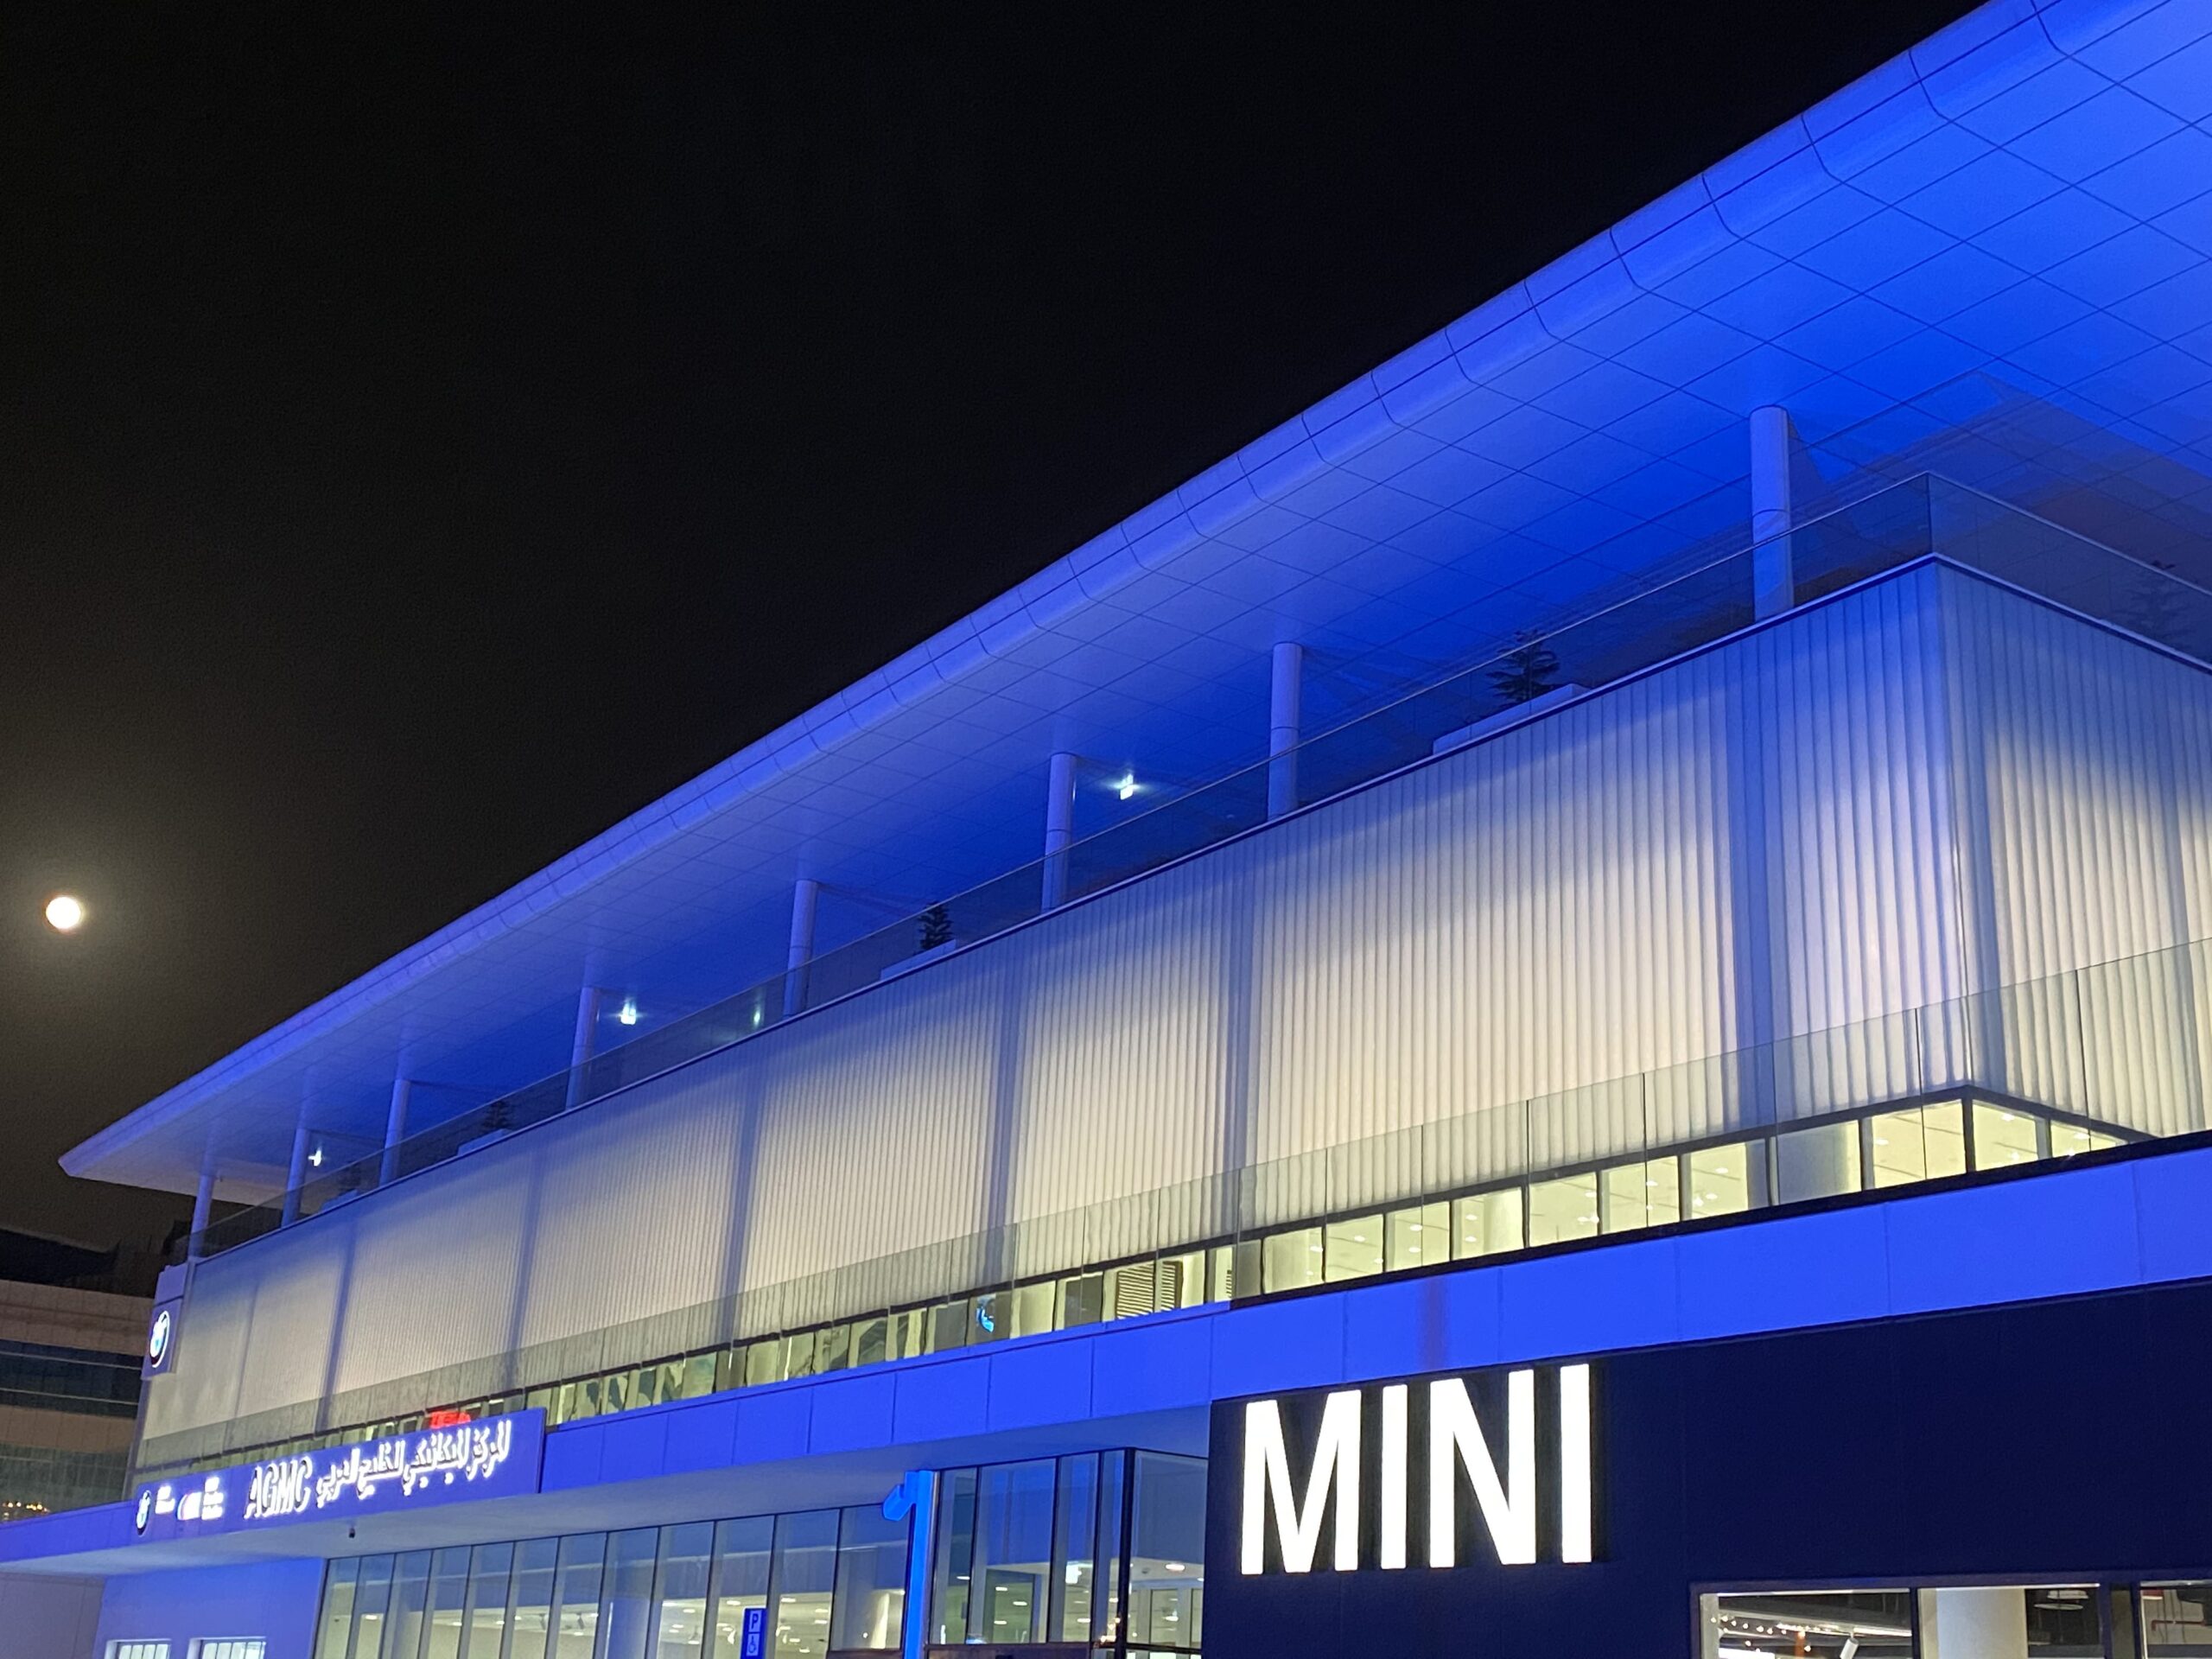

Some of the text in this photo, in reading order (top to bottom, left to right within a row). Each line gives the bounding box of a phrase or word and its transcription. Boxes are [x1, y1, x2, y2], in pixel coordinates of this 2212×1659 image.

[244, 1456, 312, 1518] AGMC
[1242, 1363, 1592, 1574] MINI
[752, 1612, 759, 1629] P
